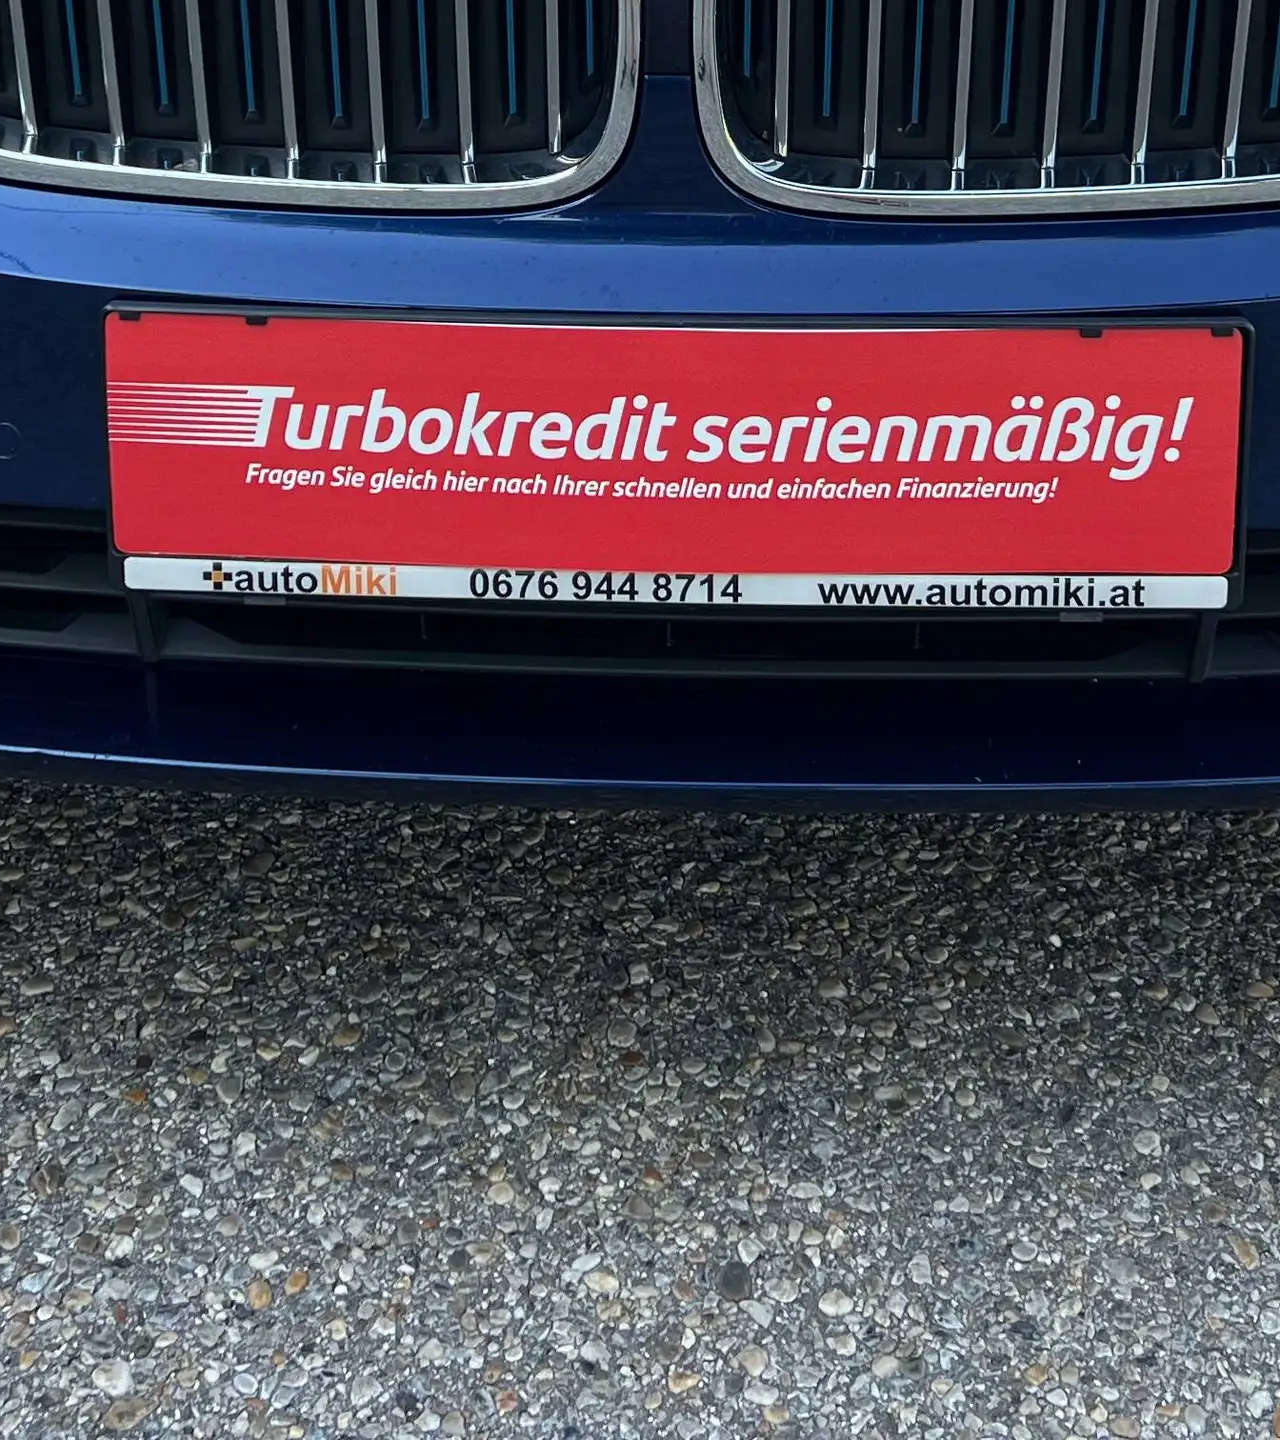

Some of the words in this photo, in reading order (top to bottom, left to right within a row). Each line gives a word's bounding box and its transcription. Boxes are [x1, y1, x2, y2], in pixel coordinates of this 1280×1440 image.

[246, 385, 677, 463] Turbokredit
[686, 395, 1194, 481] serienmäßig!
[246, 464, 325, 490] Fragen
[330, 466, 366, 488] Sie
[370, 468, 438, 493] gleich
[443, 471, 489, 492] hier
[492, 474, 548, 495] nach
[552, 475, 610, 497] Ihrer
[612, 477, 722, 499] schnellen
[728, 478, 773, 499] und
[777, 478, 891, 499] einfachen
[896, 477, 1058, 503] Finanzierung!
[469, 569, 560, 600] 0676
[572, 570, 639, 601] 944
[653, 572, 743, 604] 8714
[817, 577, 1146, 609] www.automiki.at
